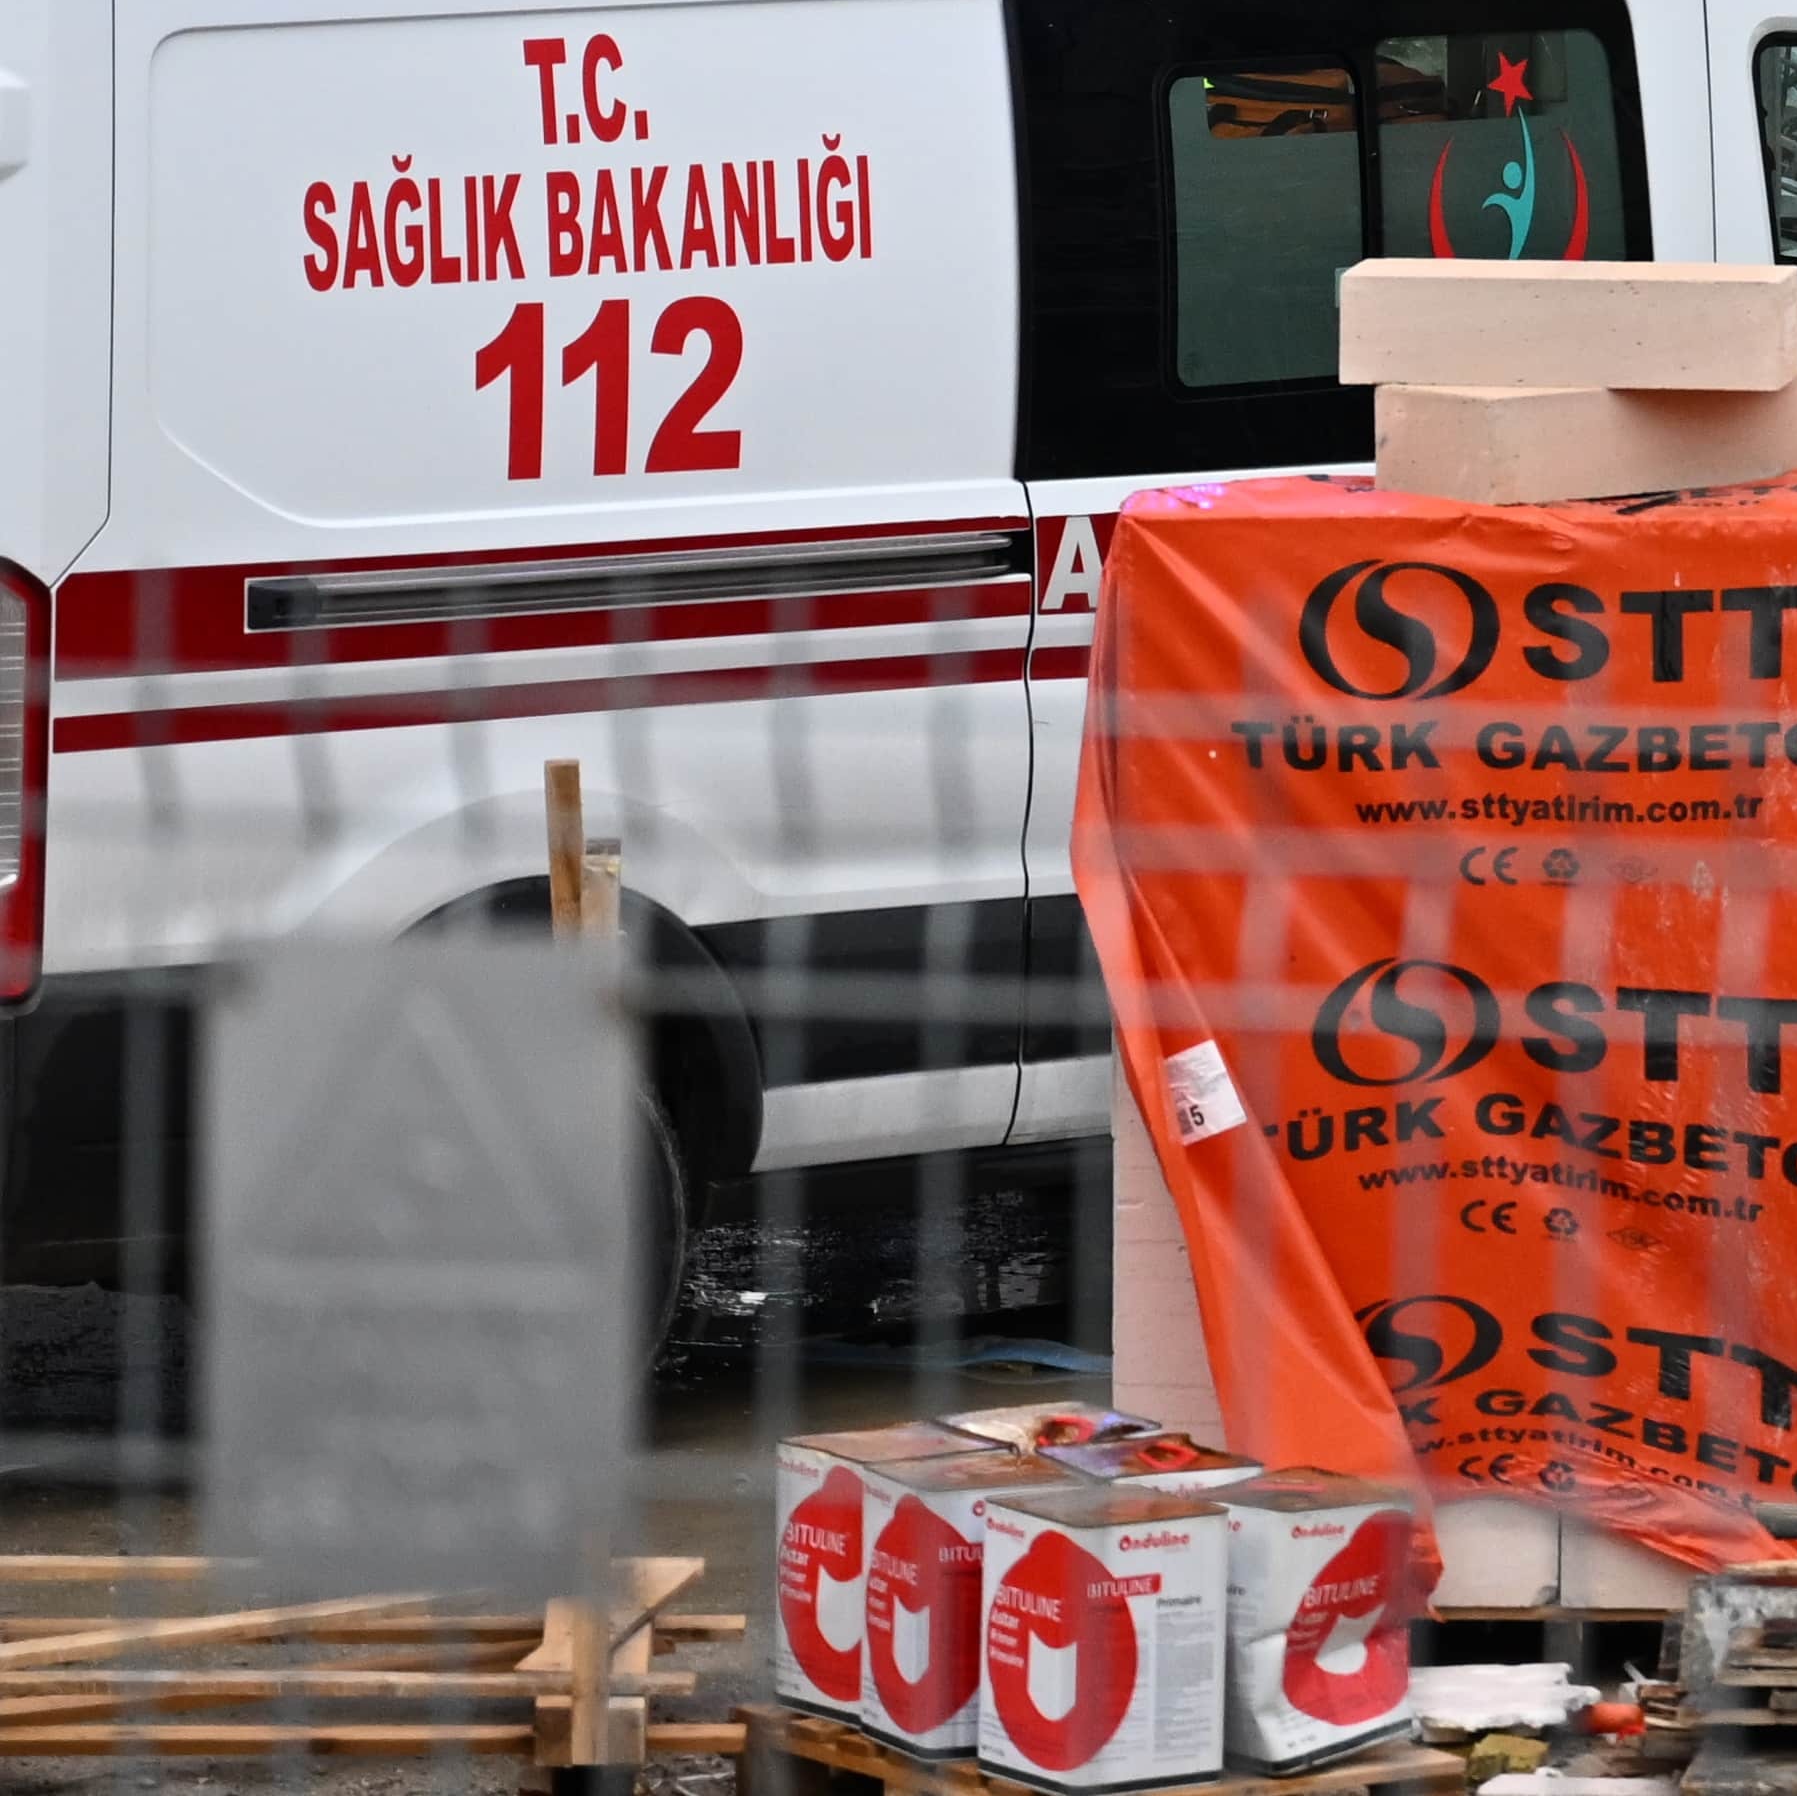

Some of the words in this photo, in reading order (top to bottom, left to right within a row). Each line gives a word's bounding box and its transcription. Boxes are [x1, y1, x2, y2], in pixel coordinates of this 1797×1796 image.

[522, 33, 649, 146] T.C.
[302, 154, 525, 292] SAĞLIK
[546, 132, 873, 277] BAKANLIĞI
[473, 295, 745, 482] 112
[1231, 715, 1441, 772] TÜRK
[1264, 1097, 1446, 1162] ÜRK
[787, 1522, 847, 1557] BITULINE
[1119, 1533, 1190, 1552] Onduline
[997, 1584, 1062, 1623] BITULINE
[1087, 1578, 1154, 1599] BITULINE
